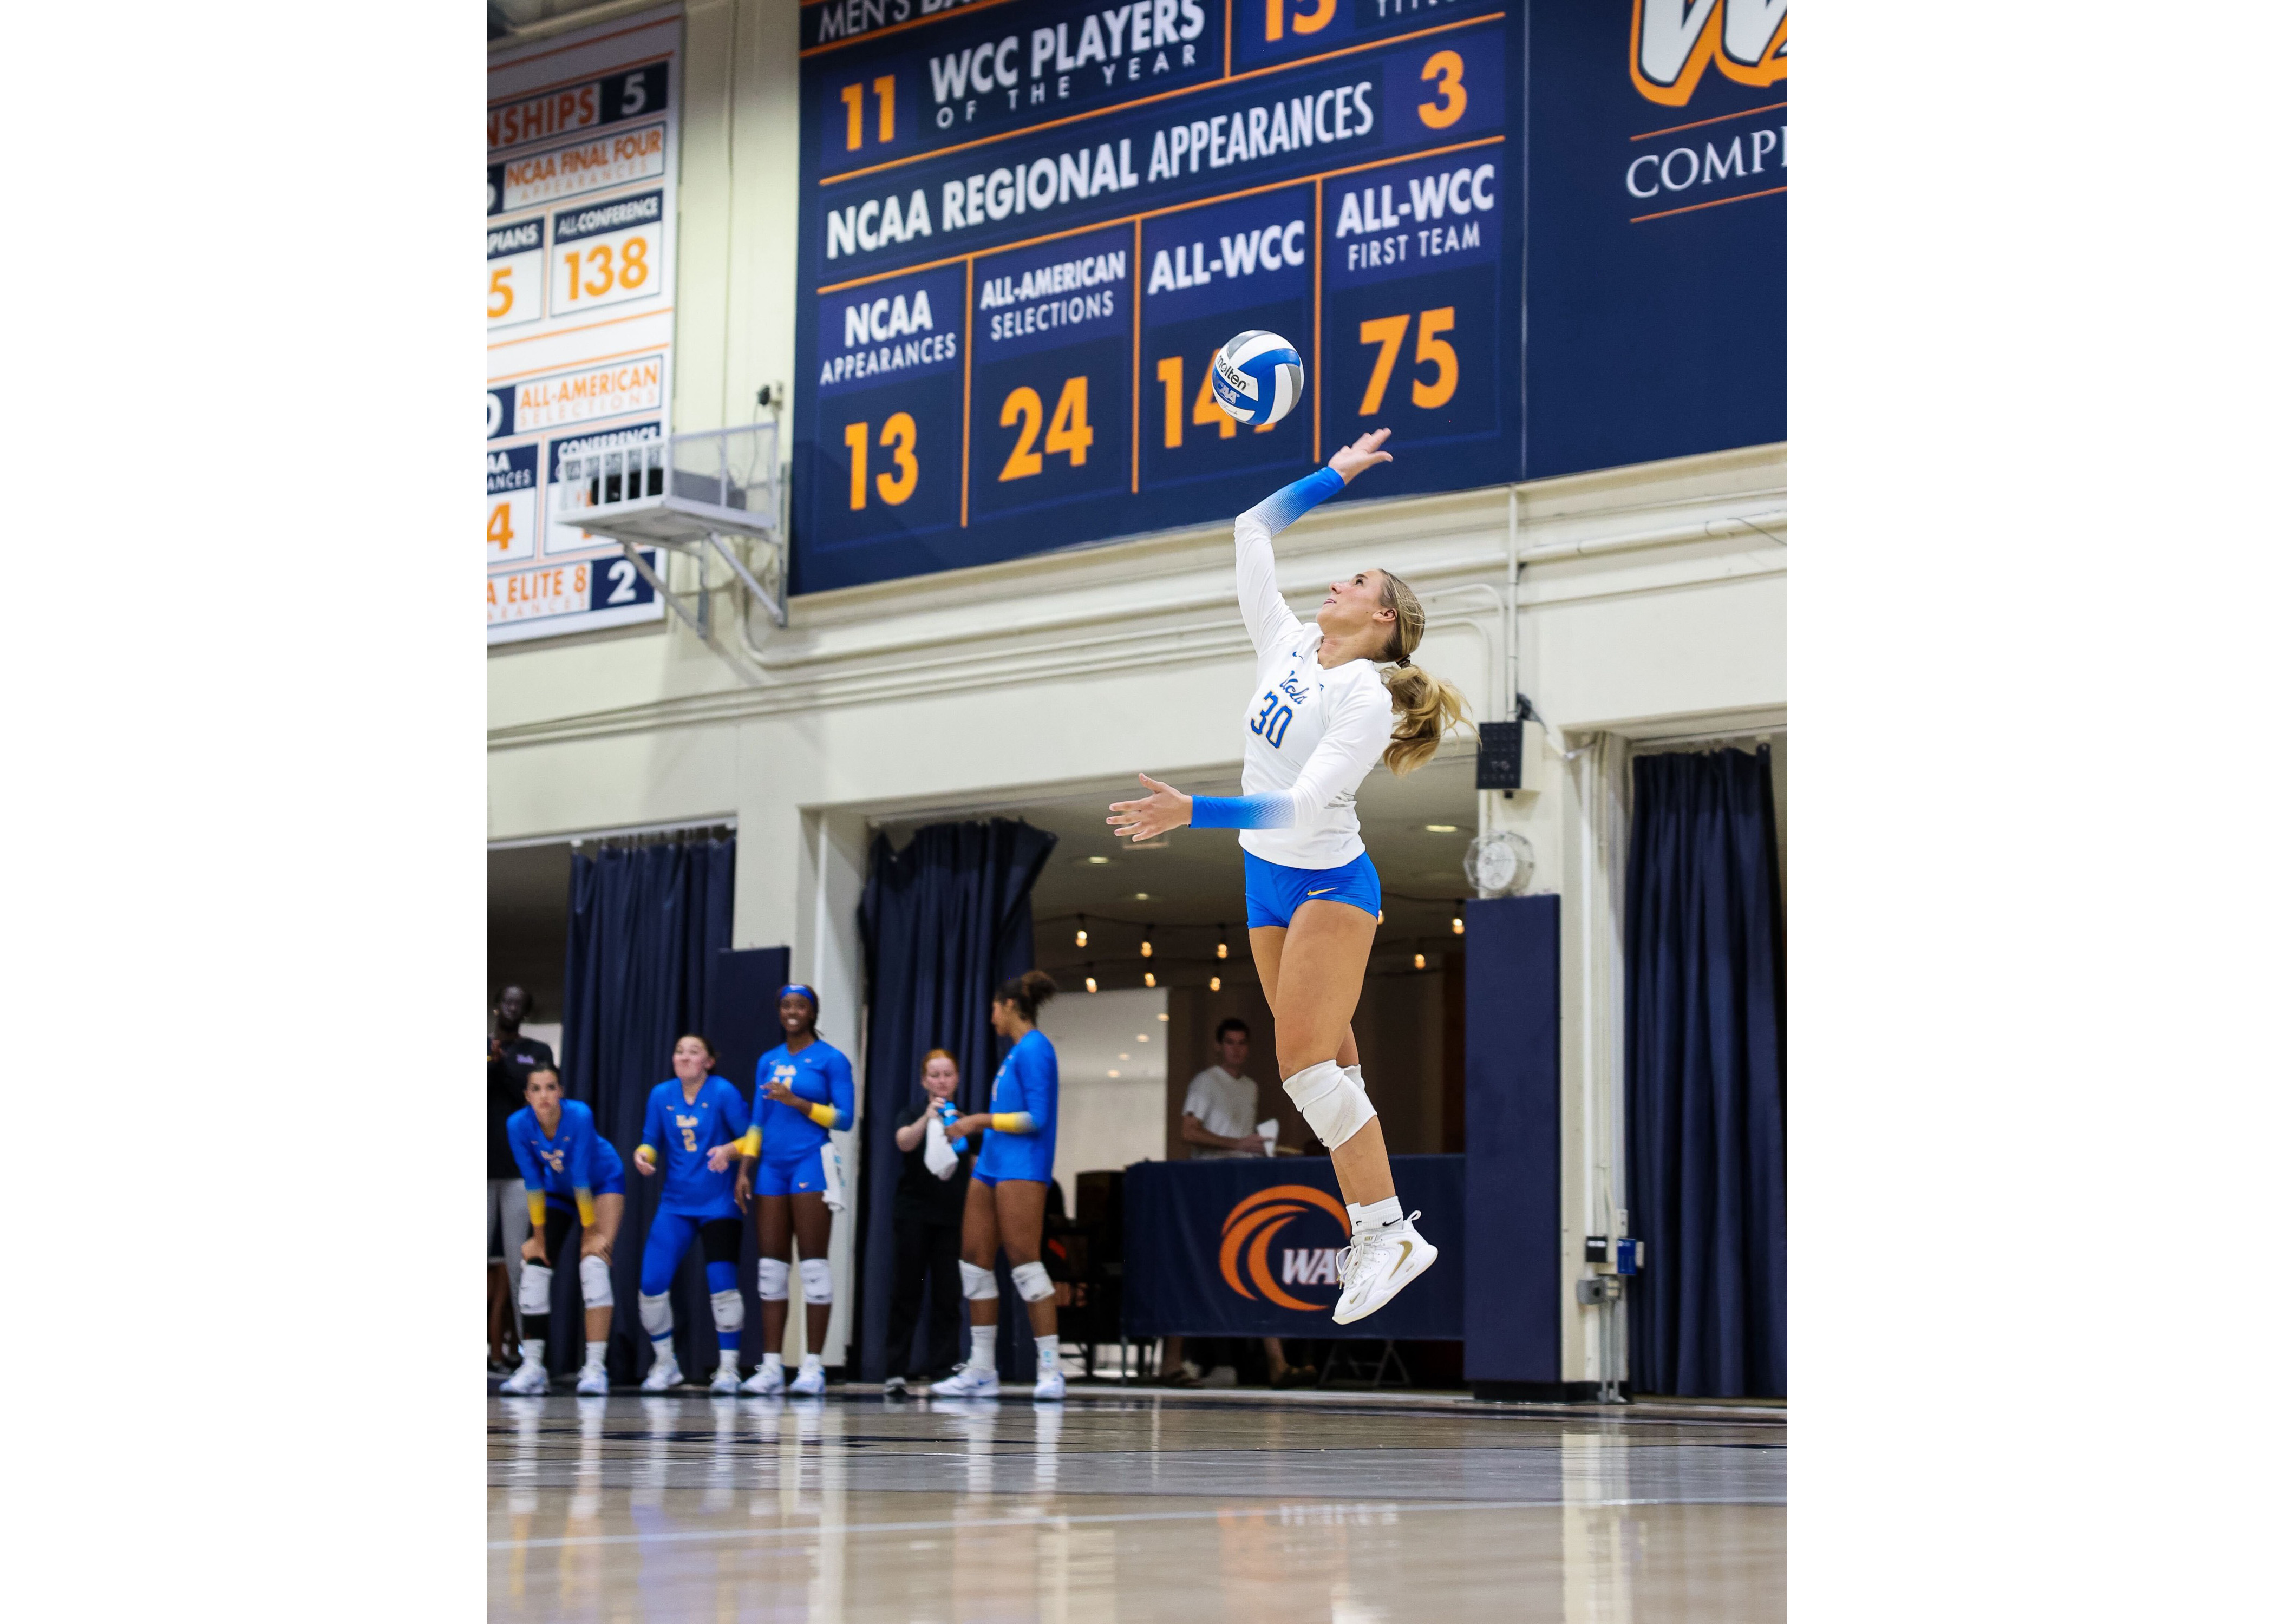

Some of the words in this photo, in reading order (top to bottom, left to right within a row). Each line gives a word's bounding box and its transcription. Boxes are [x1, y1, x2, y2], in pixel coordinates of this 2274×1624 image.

[818, 0, 910, 42] MENS
[930, 36, 1019, 104] WCC
[1031, 0, 1205, 78] PLAYERS
[621, 72, 647, 115] 5
[841, 74, 895, 152] 11
[936, 101, 977, 129] OF
[1008, 75, 1070, 110] THE
[1102, 43, 1196, 87] YEAR
[506, 156, 557, 189] NCAA
[561, 142, 609, 174] FINAL
[613, 129, 662, 162] FOUR
[827, 189, 932, 260] NCAA
[942, 139, 1139, 232] REGIONAL
[1147, 81, 1374, 183] APPEARANCES
[1417, 50, 1468, 130] 3
[1626, 126, 1786, 198] COMP
[1336, 164, 1495, 239] ALL-WCC
[564, 236, 649, 302] 138
[1147, 220, 1305, 295] ALL-WCC
[1348, 234, 1409, 271] FIRST
[1418, 221, 1481, 258] TEAM
[979, 250, 1126, 310] ALL-AMERICAN
[844, 289, 933, 348] NCAA
[990, 290, 1114, 342] SELECTIONS
[520, 362, 658, 410] ALL-AMERICAN
[819, 332, 957, 387] APPEARANCES
[1216, 355, 1247, 391] molten
[1358, 306, 1459, 417] 75
[998, 376, 1094, 482] 24
[1156, 348, 1278, 450] 14
[845, 411, 919, 511] 13
[508, 569, 564, 604] ELITE
[573, 564, 587, 594] 8
[606, 559, 637, 605] 2
[1251, 690, 1293, 749] 30
[681, 1128, 697, 1152] 2
